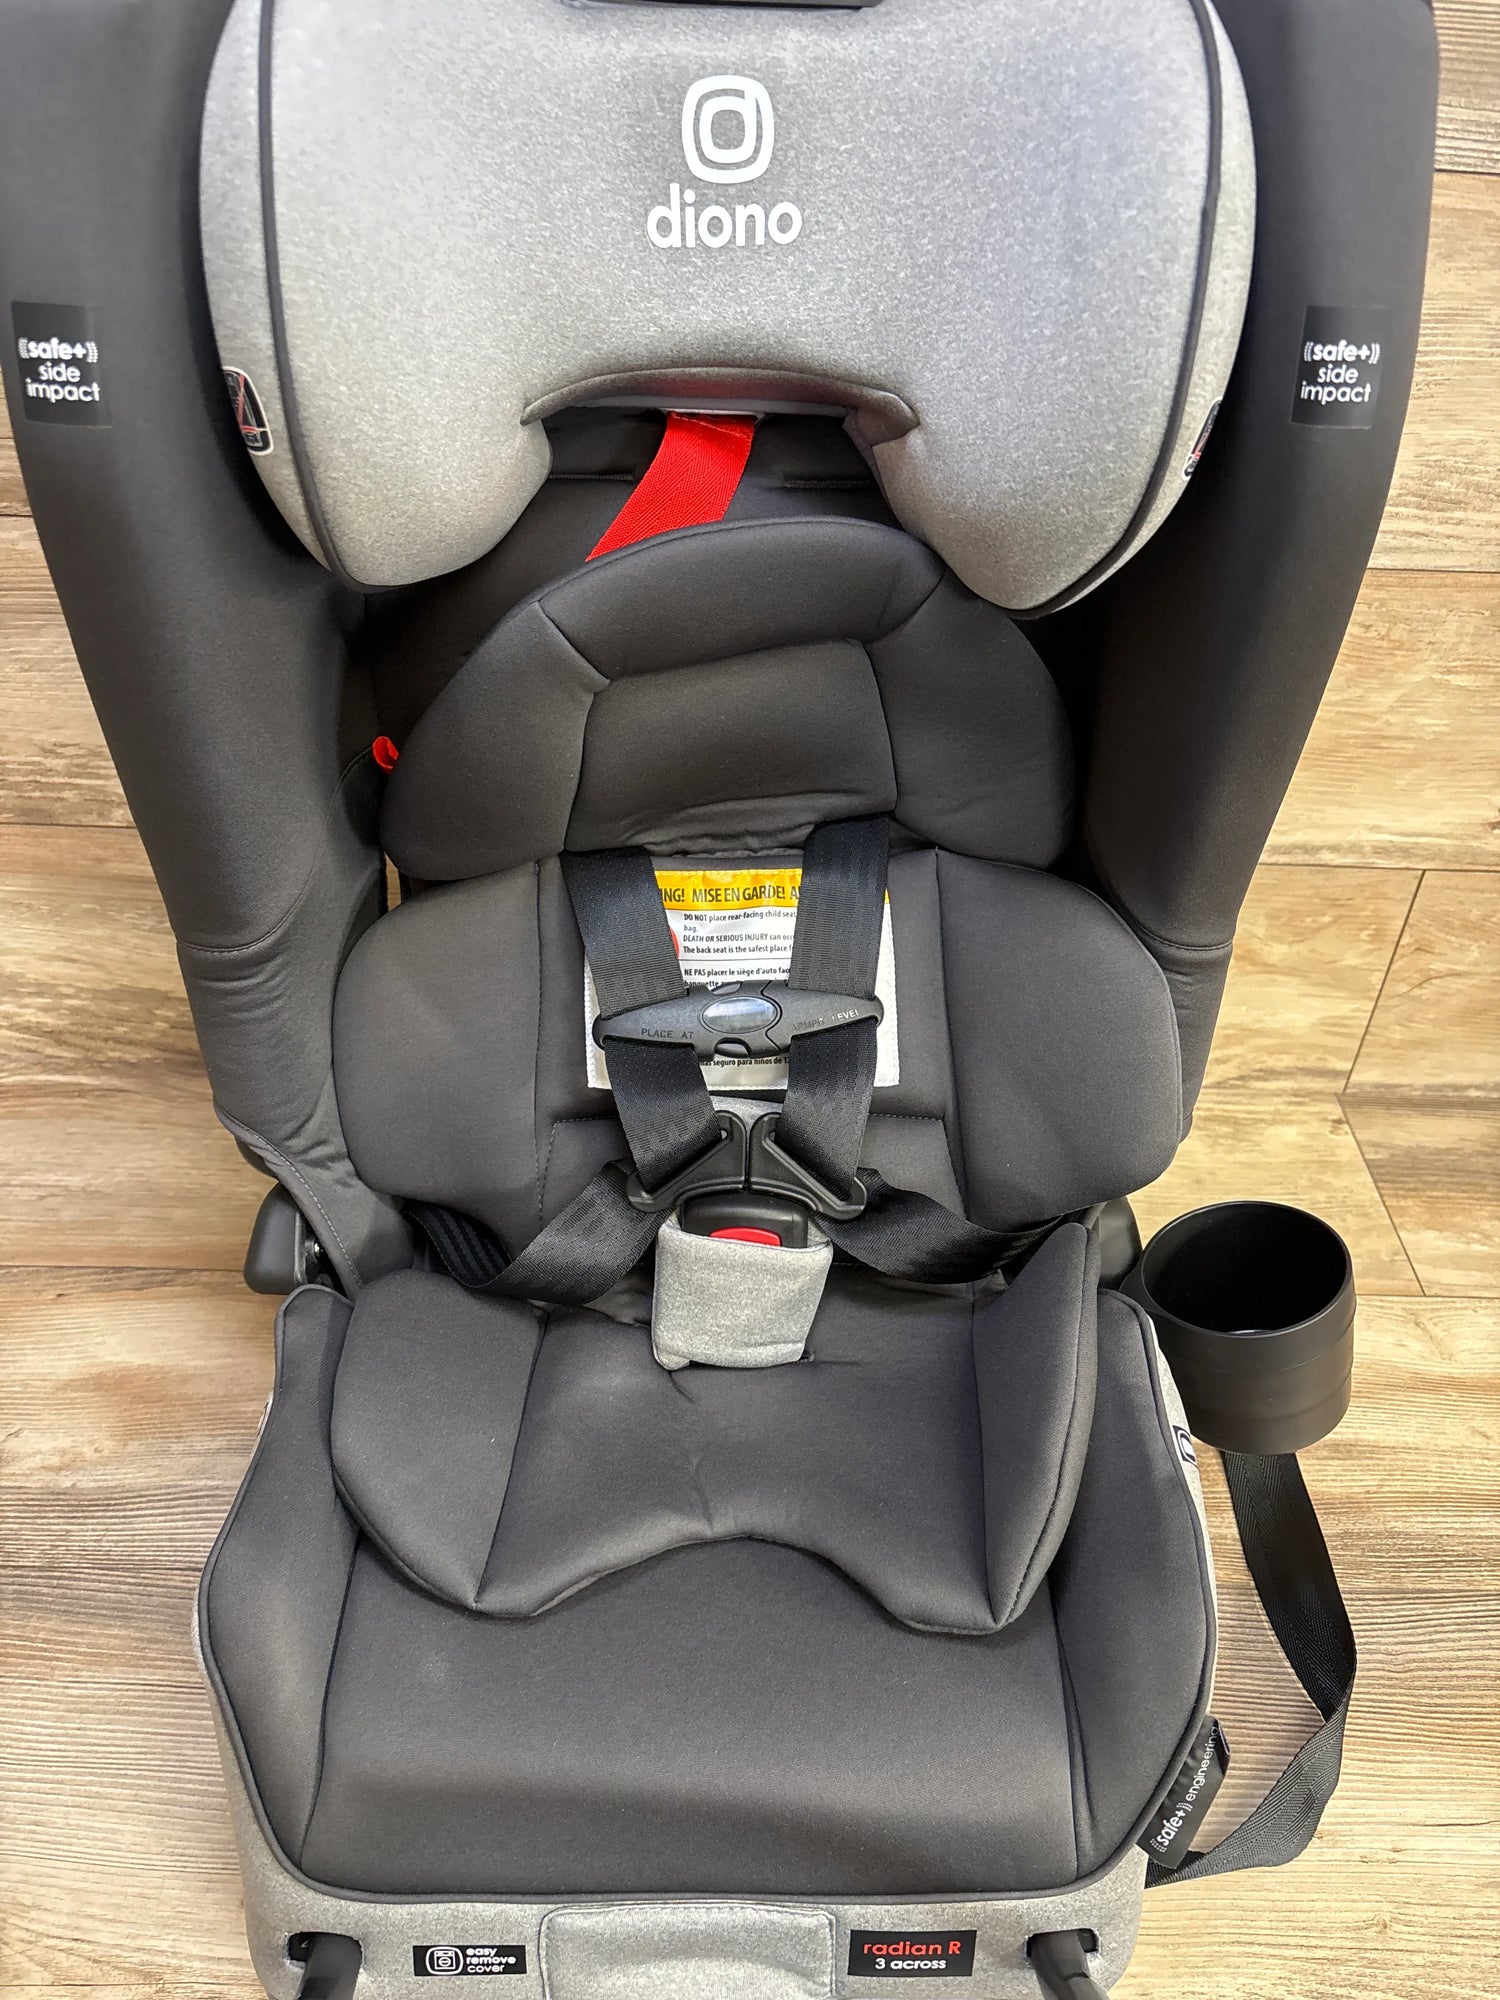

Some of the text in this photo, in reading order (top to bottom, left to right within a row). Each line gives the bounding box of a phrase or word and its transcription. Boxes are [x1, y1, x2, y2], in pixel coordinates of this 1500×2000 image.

[647, 182, 802, 249] diono
[38, 361, 81, 383] side
[1317, 363, 1359, 384] side
[25, 377, 100, 403] impact
[1300, 381, 1372, 406] impact
[692, 887, 722, 903] MISE
[724, 887, 740, 902] EN
[742, 884, 785, 902] GARDE!
[684, 913, 693, 921] DO
[694, 913, 707, 922] NOT
[709, 913, 727, 923] place
[728, 911, 764, 921] rear-facing
[765, 910, 781, 918] child
[683, 924, 699, 933] bag.
[683, 934, 704, 942] DEATH
[716, 933, 743, 942] SERIOUS
[744, 933, 769, 942] INJURY
[683, 946, 695, 954] The
[696, 945, 711, 954] back
[712, 946, 727, 954] seat
[728, 945, 734, 953] is
[735, 945, 747, 953] the
[748, 944, 769, 953] safest
[769, 943, 788, 953] place
[684, 968, 693, 976] NE
[694, 968, 706, 976] PAS
[707, 968, 728, 977] placer
[728, 968, 736, 976] le
[736, 967, 754, 977] siège
[641, 1008, 860, 1040] PLACE AT ARMPIT LEVEL
[713, 1059, 736, 1068] seguro
[737, 1059, 752, 1067] para
[773, 1056, 782, 1064] de
[1185, 1726, 1219, 1803] engineering
[465, 1947, 498, 1957] easy
[863, 1940, 961, 1956] radian R
[465, 1955, 517, 1965] remove
[874, 1957, 947, 1970] 3 across
[466, 1964, 505, 1973] cover
